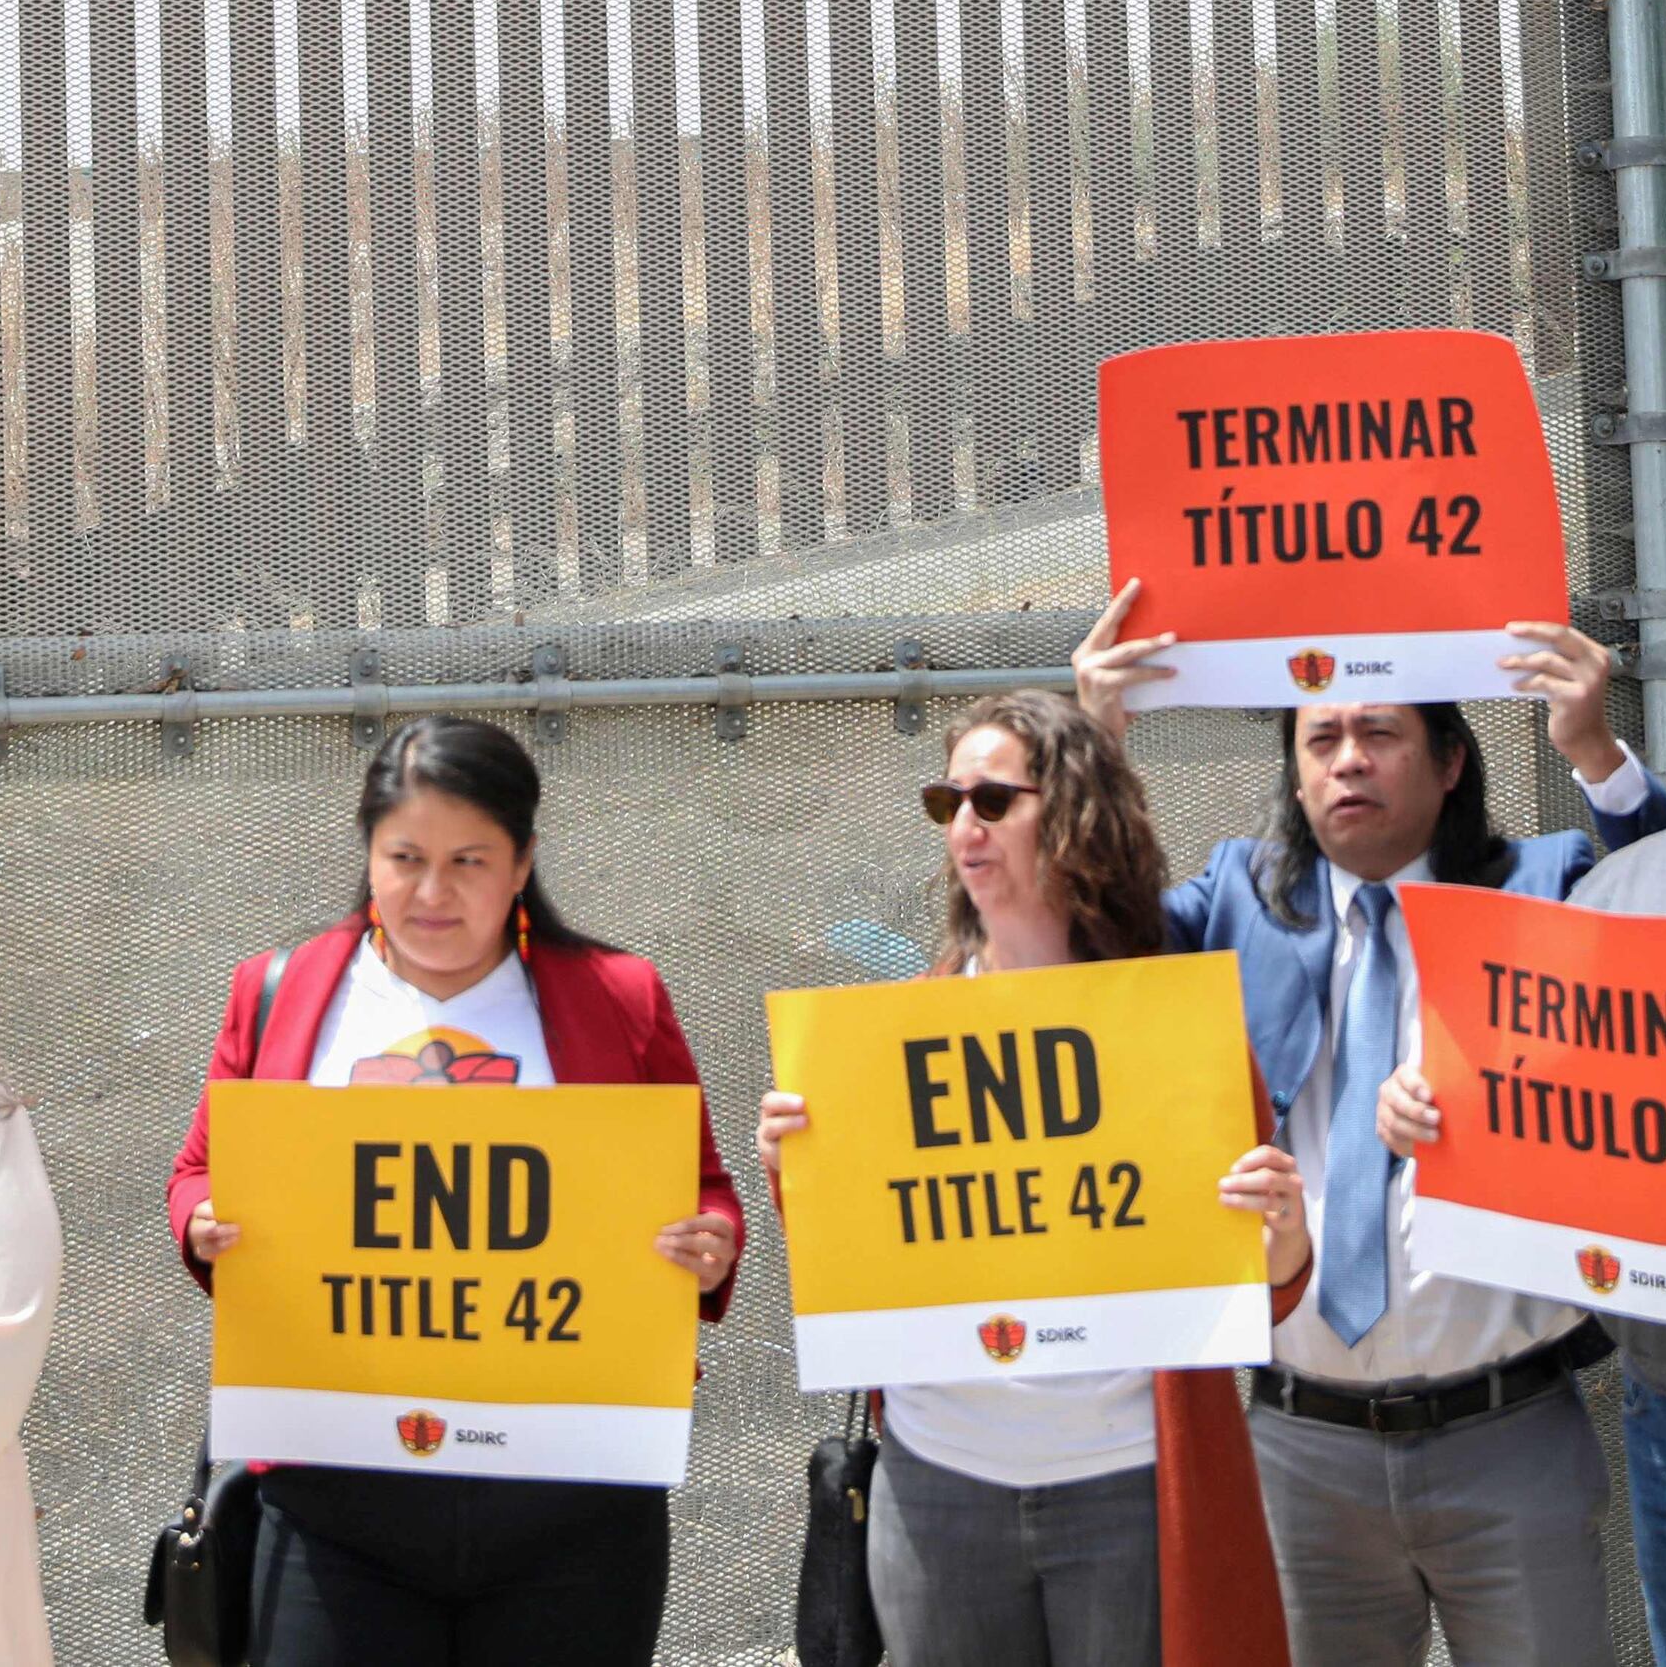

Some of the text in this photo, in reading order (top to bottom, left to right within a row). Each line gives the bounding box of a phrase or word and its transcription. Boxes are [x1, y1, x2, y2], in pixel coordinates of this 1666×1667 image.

[1176, 397, 1477, 470] TERMINAR
[1182, 487, 1481, 567] TÍTULO 42
[1344, 661, 1393, 676] SDIRC
[903, 1028, 1101, 1149] END
[353, 1143, 551, 1251] END
[888, 1162, 1145, 1243] TITLE 42
[321, 1275, 581, 1342] TITLE 42
[1036, 1326, 1087, 1343] SDIRC
[455, 1429, 508, 1447] SDIRC
